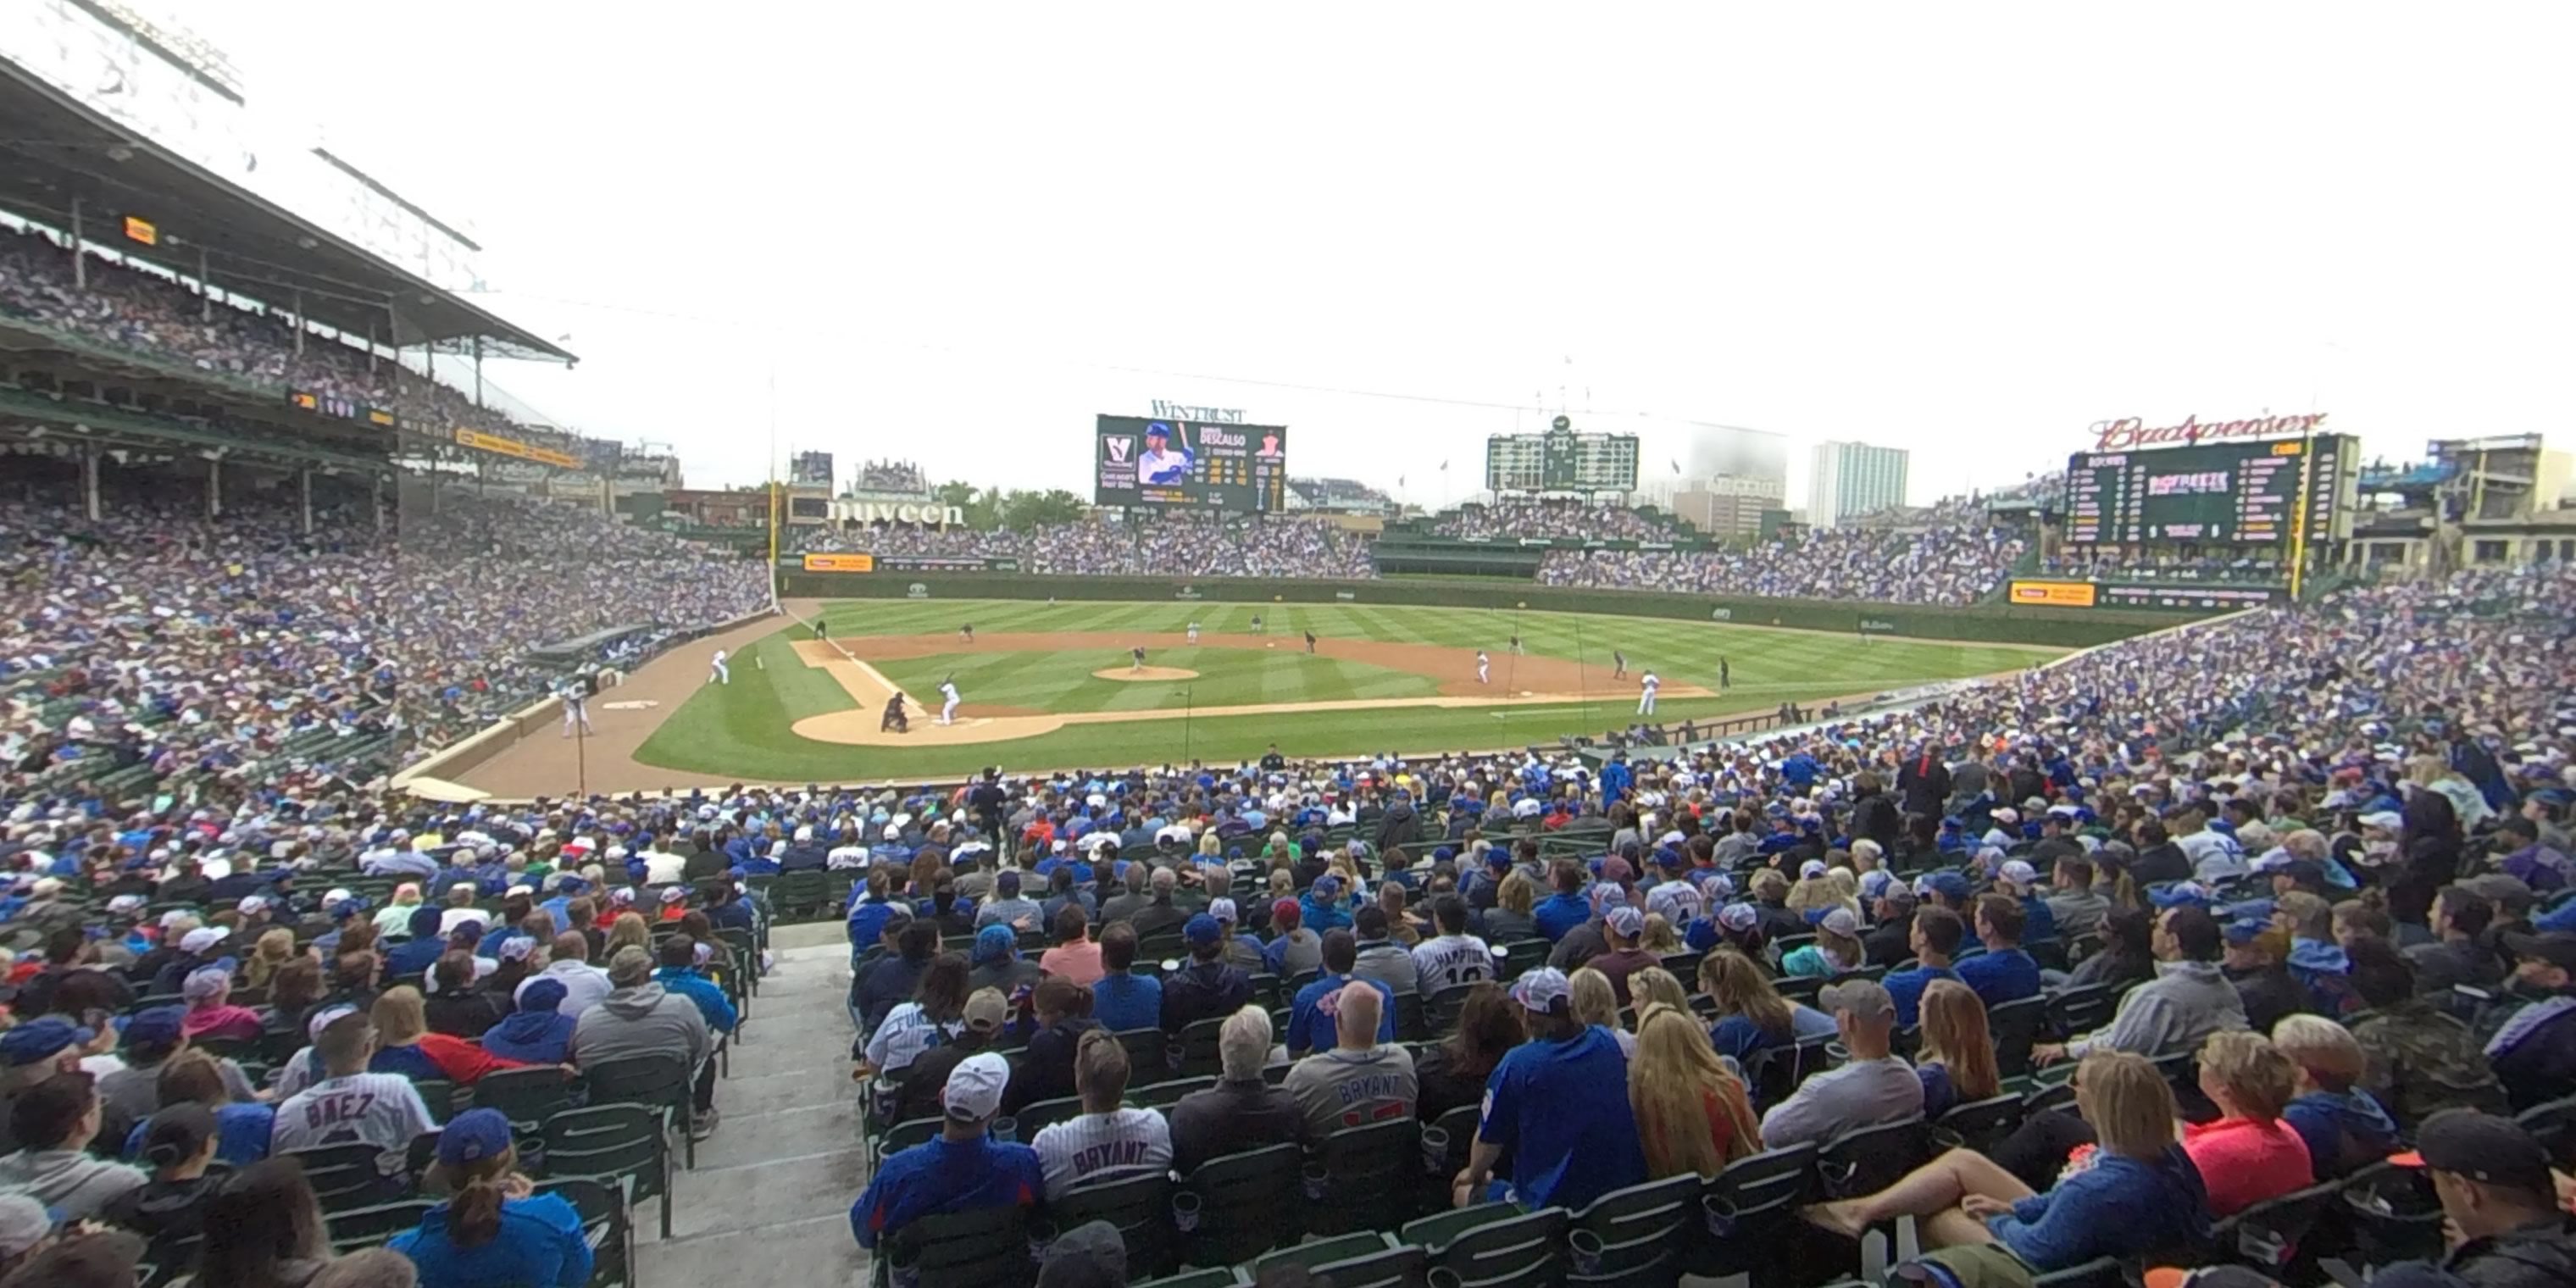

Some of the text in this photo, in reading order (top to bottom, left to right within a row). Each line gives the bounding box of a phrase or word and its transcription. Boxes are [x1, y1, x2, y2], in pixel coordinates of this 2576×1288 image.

[1200, 433, 1246, 447] DESCALSO
[2089, 414, 2328, 451] Budweiser
[827, 501, 963, 525] nuveen
[1341, 1074, 1401, 1105] BRYANT
[305, 1093, 375, 1130] BAEZ
[1072, 1140, 1149, 1177] BRYANT
